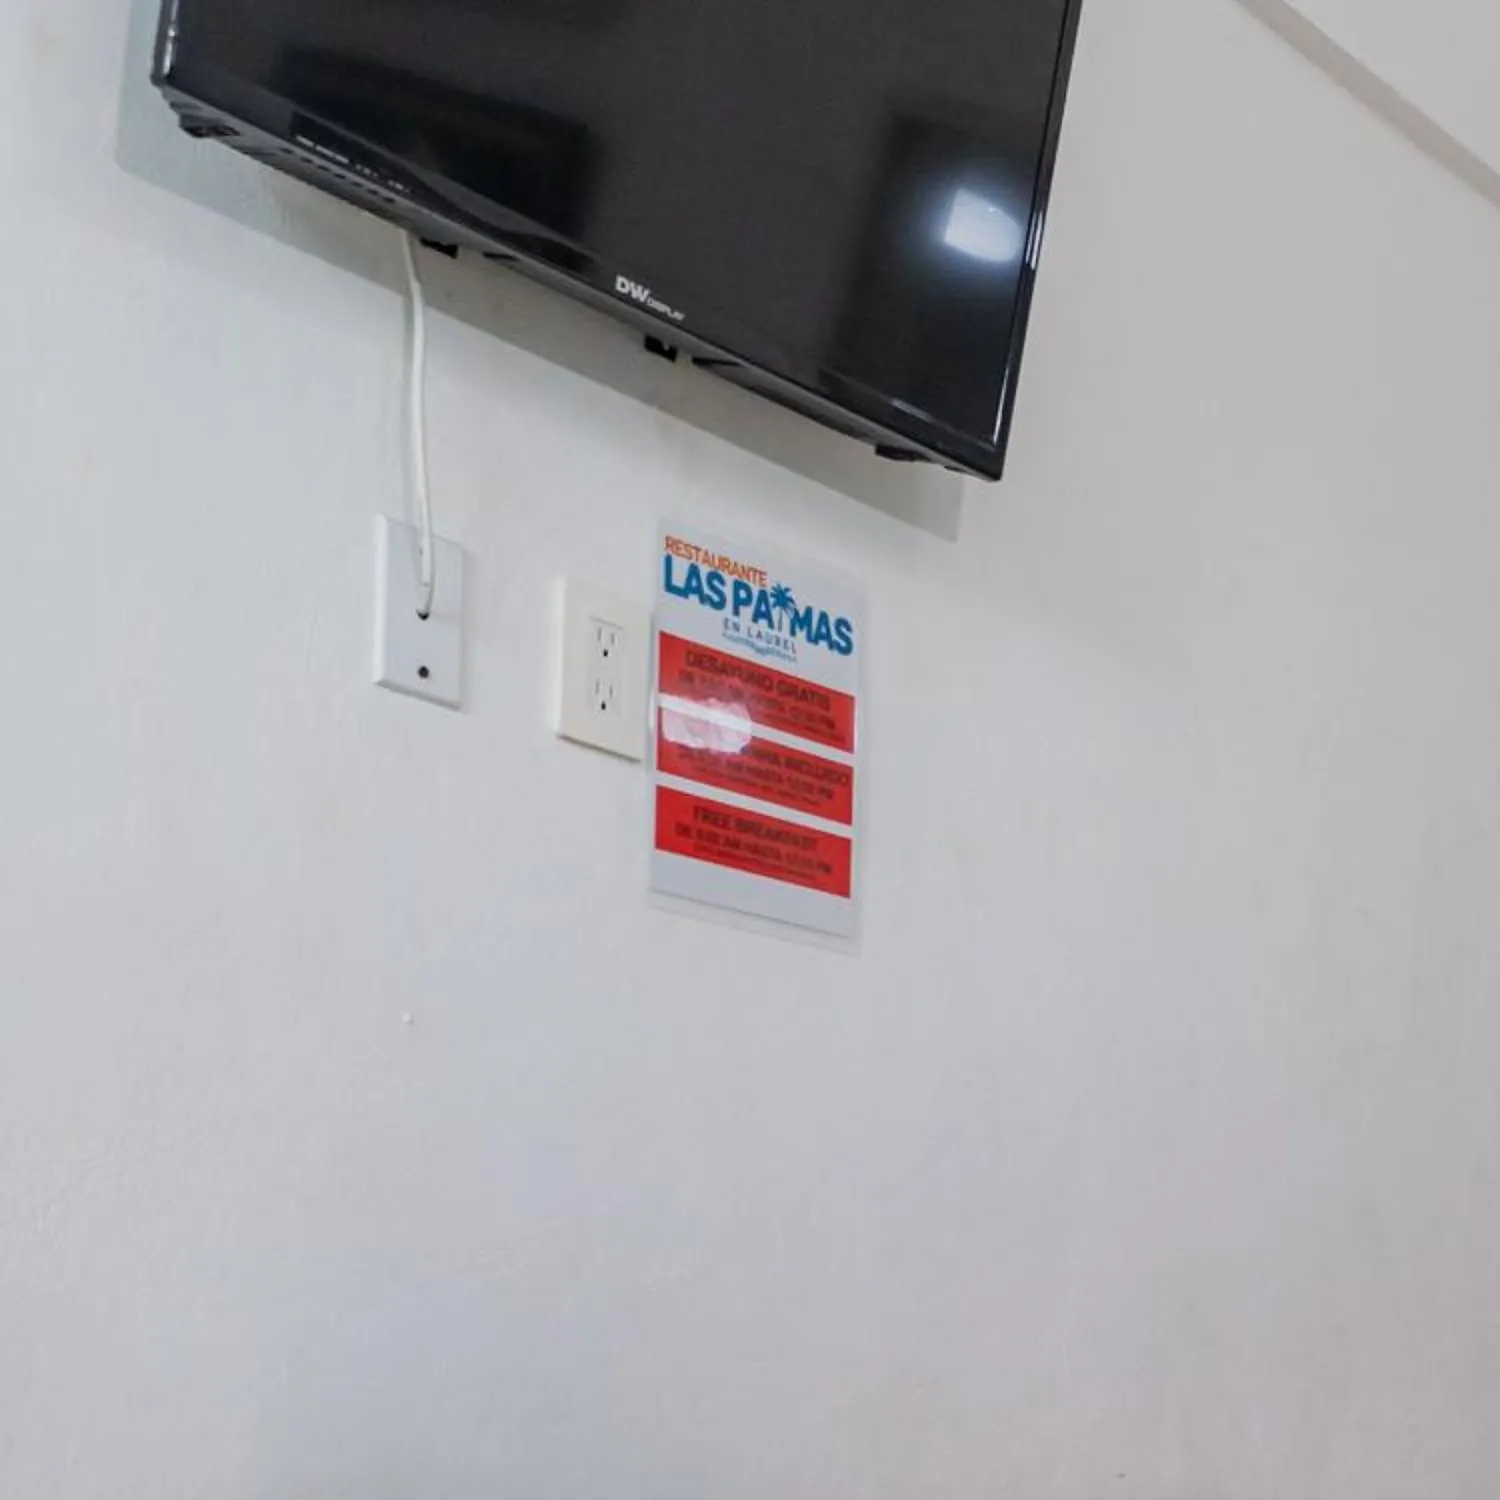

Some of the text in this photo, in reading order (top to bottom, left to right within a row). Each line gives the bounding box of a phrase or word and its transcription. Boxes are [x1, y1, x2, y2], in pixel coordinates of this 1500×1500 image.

[615, 274, 650, 303] DW
[664, 536, 768, 587] RESTAURANTE
[664, 554, 727, 611] LAS
